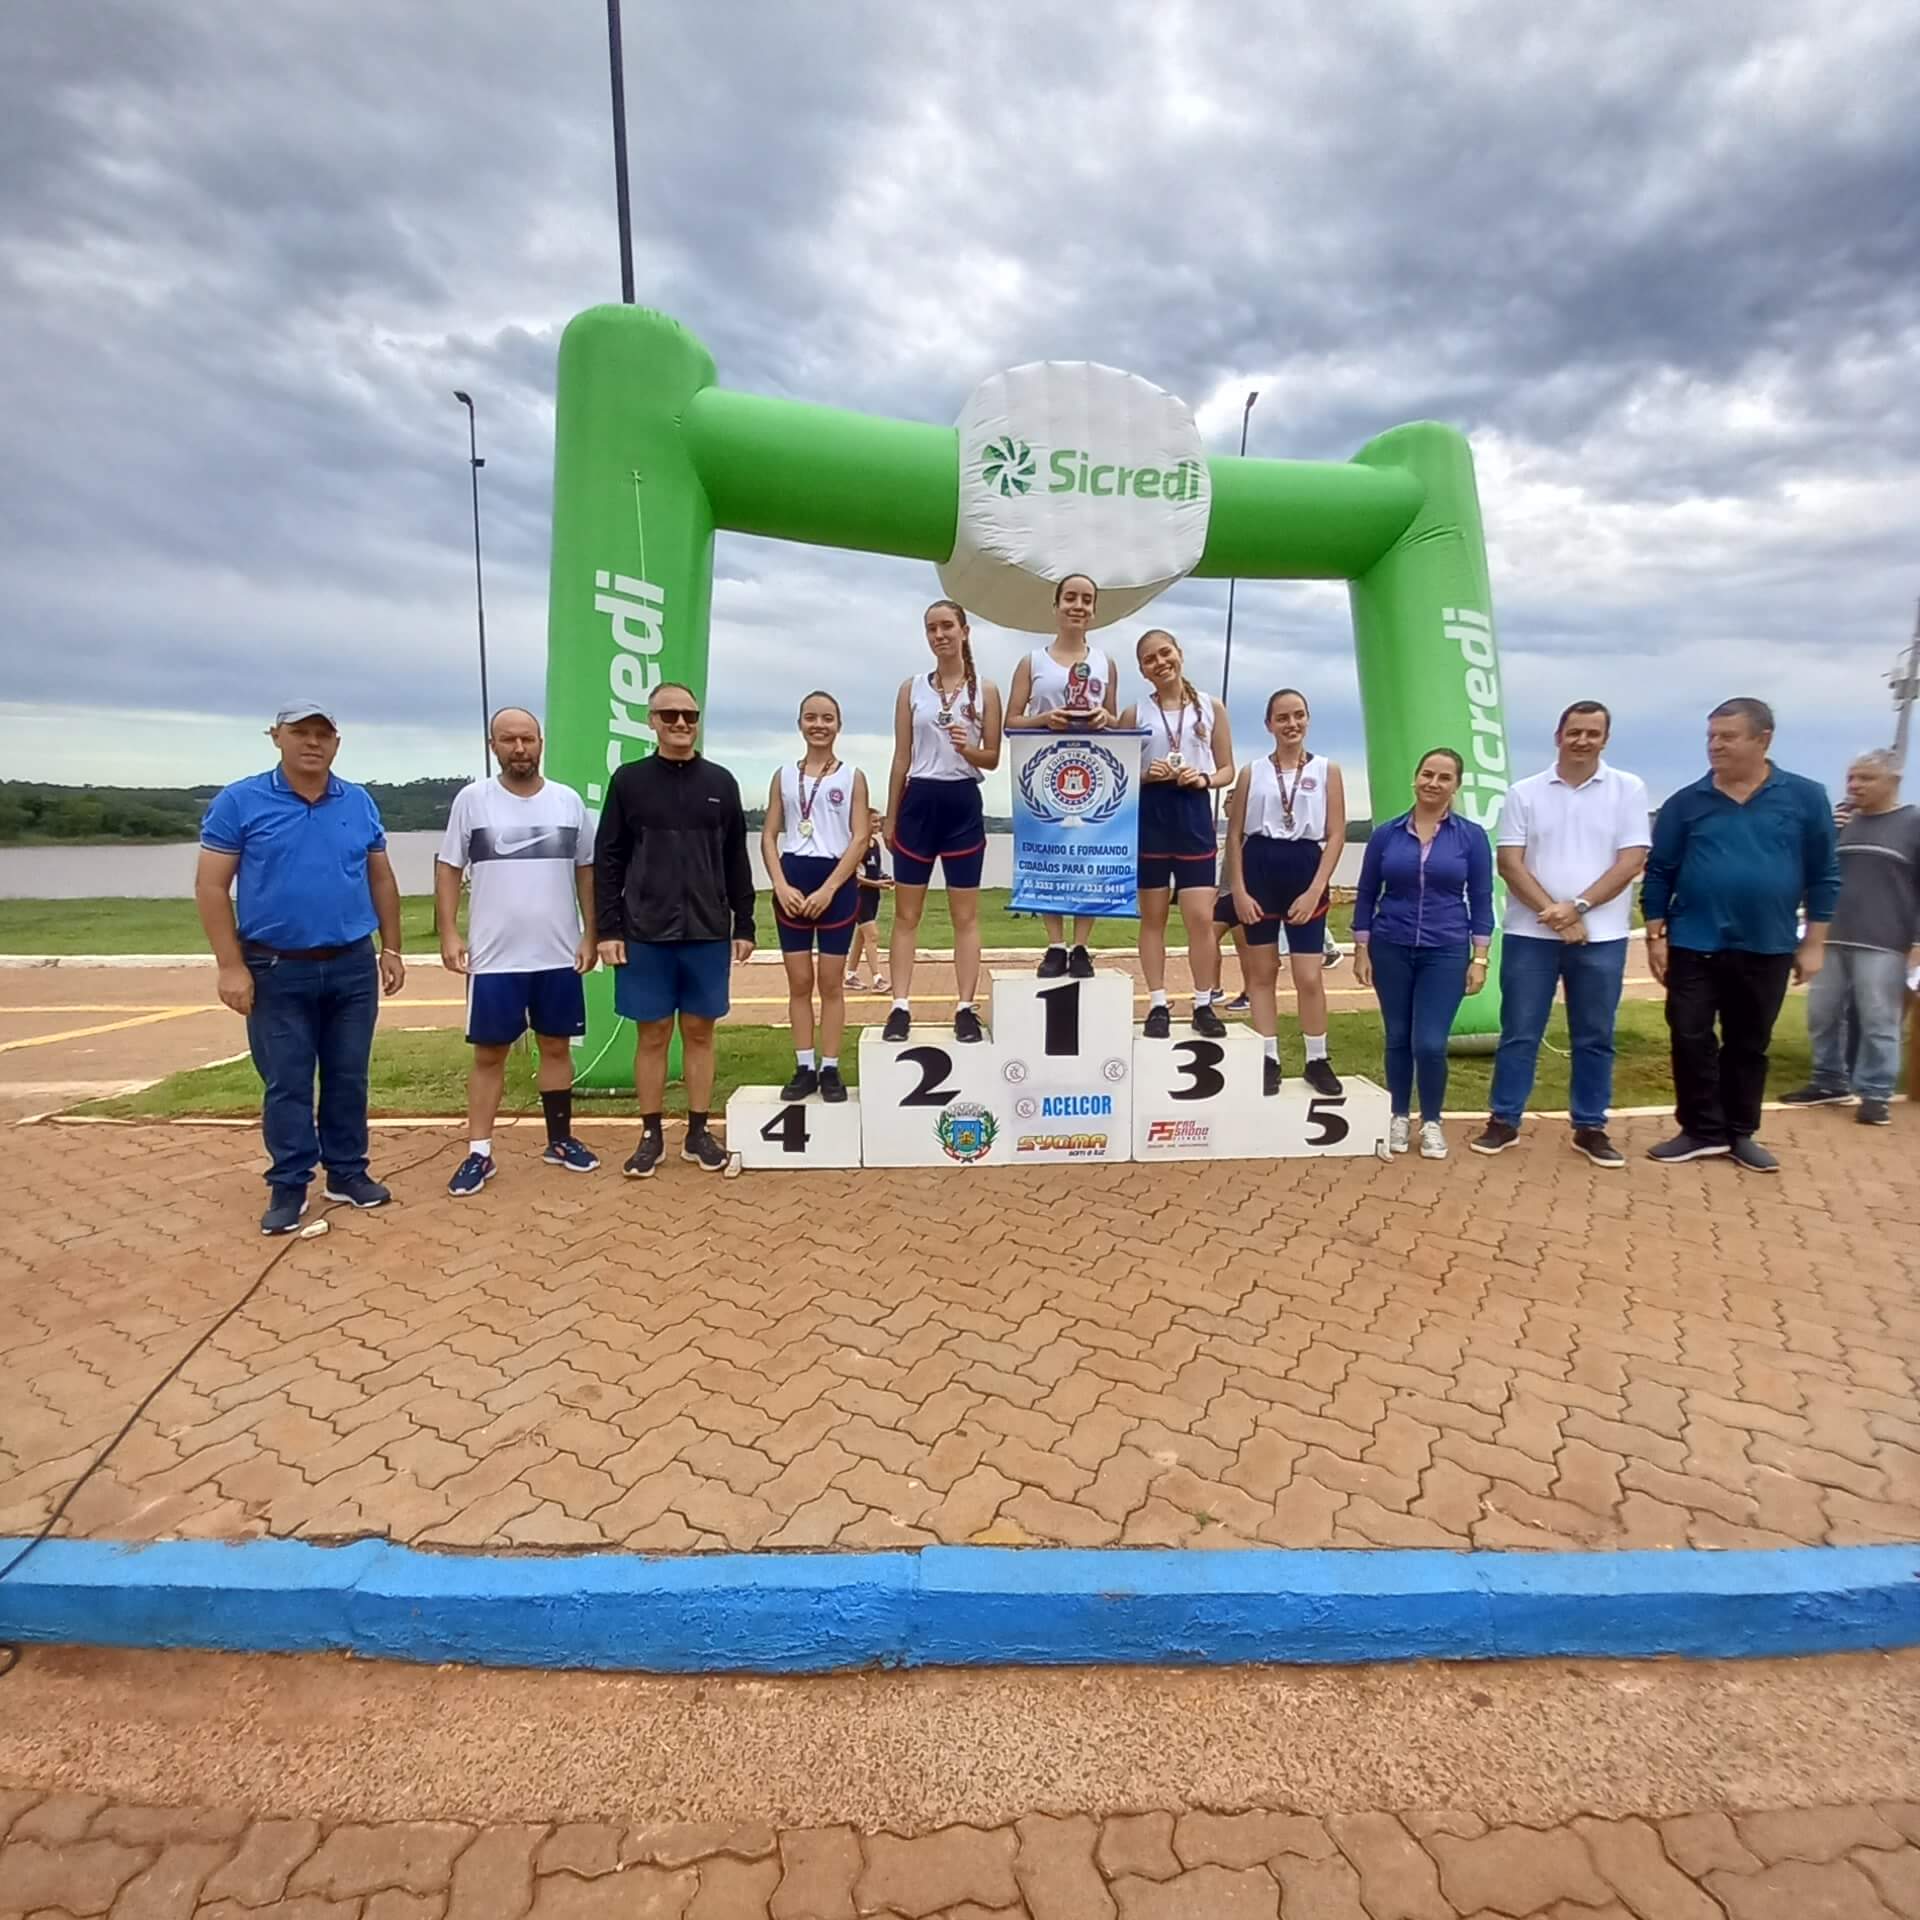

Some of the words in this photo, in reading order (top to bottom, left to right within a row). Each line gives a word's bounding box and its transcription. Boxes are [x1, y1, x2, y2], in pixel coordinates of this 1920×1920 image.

[1048, 450, 1200, 500] Sicredi
[1442, 607, 1508, 831] Sicredi
[1019, 860, 1061, 873] CIDADÃOS
[1062, 863, 1085, 875] PARA
[1087, 865, 1094, 875] O
[1096, 865, 1131, 876] MUNDO
[1022, 842, 1067, 856] EDUCANDO
[1069, 844, 1075, 856] E
[1077, 845, 1129, 857] FORMANDO
[1035, 981, 1080, 1056] 1
[895, 1046, 962, 1107] 2
[1167, 1040, 1225, 1100] 3
[760, 1104, 811, 1153] 4
[1042, 1095, 1112, 1117] ACELCOR
[1304, 1098, 1350, 1146] 5
